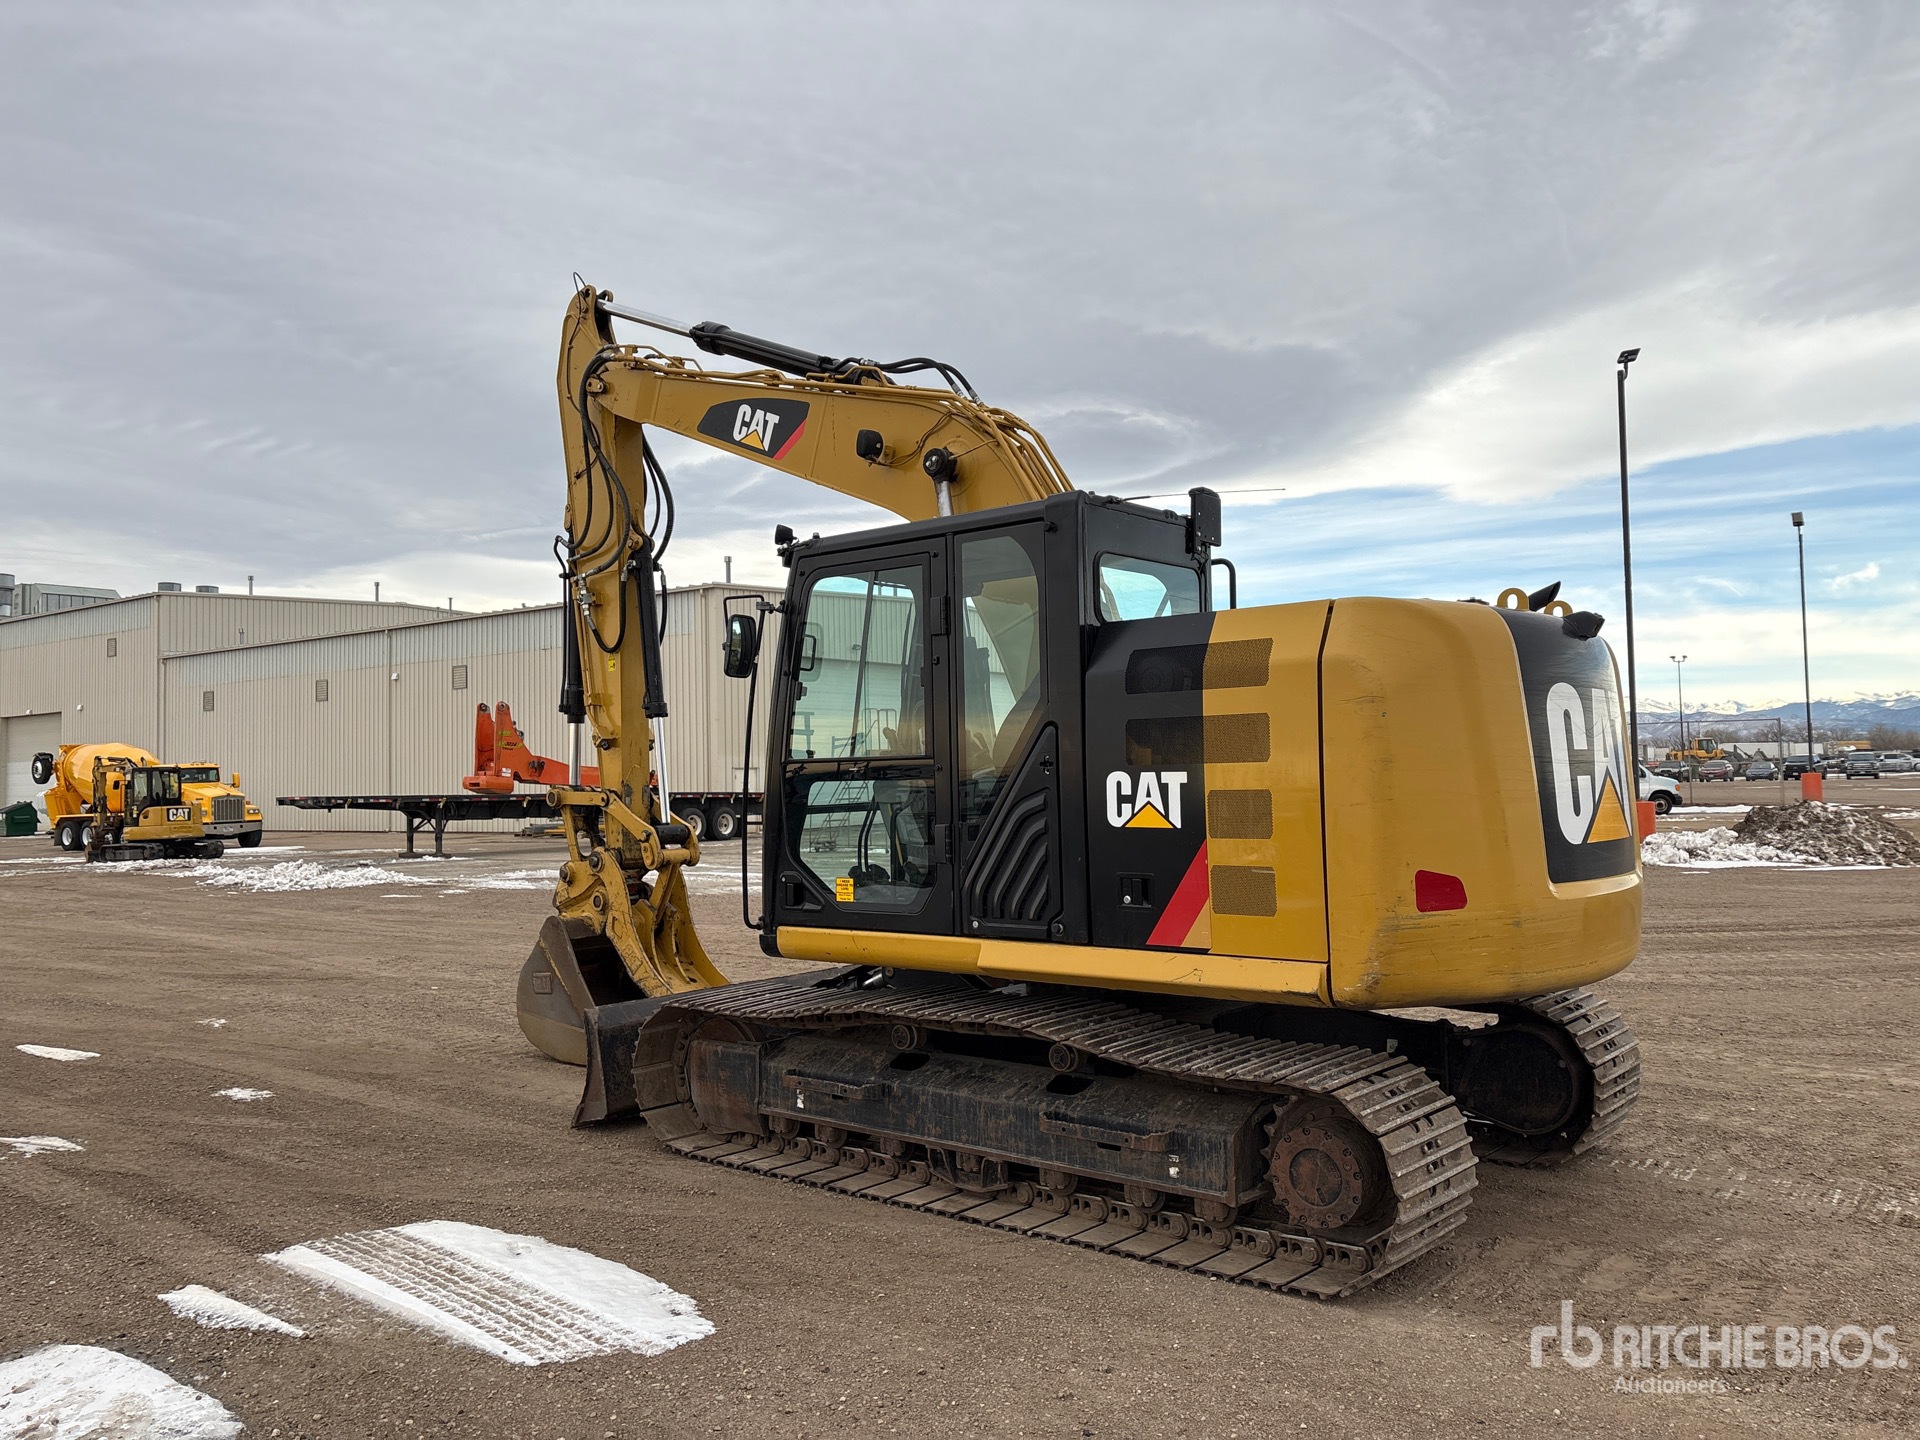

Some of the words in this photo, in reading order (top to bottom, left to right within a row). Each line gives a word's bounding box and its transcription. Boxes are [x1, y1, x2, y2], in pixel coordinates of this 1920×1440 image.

[733, 404, 780, 452] CAT
[1547, 682, 1632, 845] CAT
[169, 808, 189, 820] CAT
[1106, 770, 1188, 829] CAT
